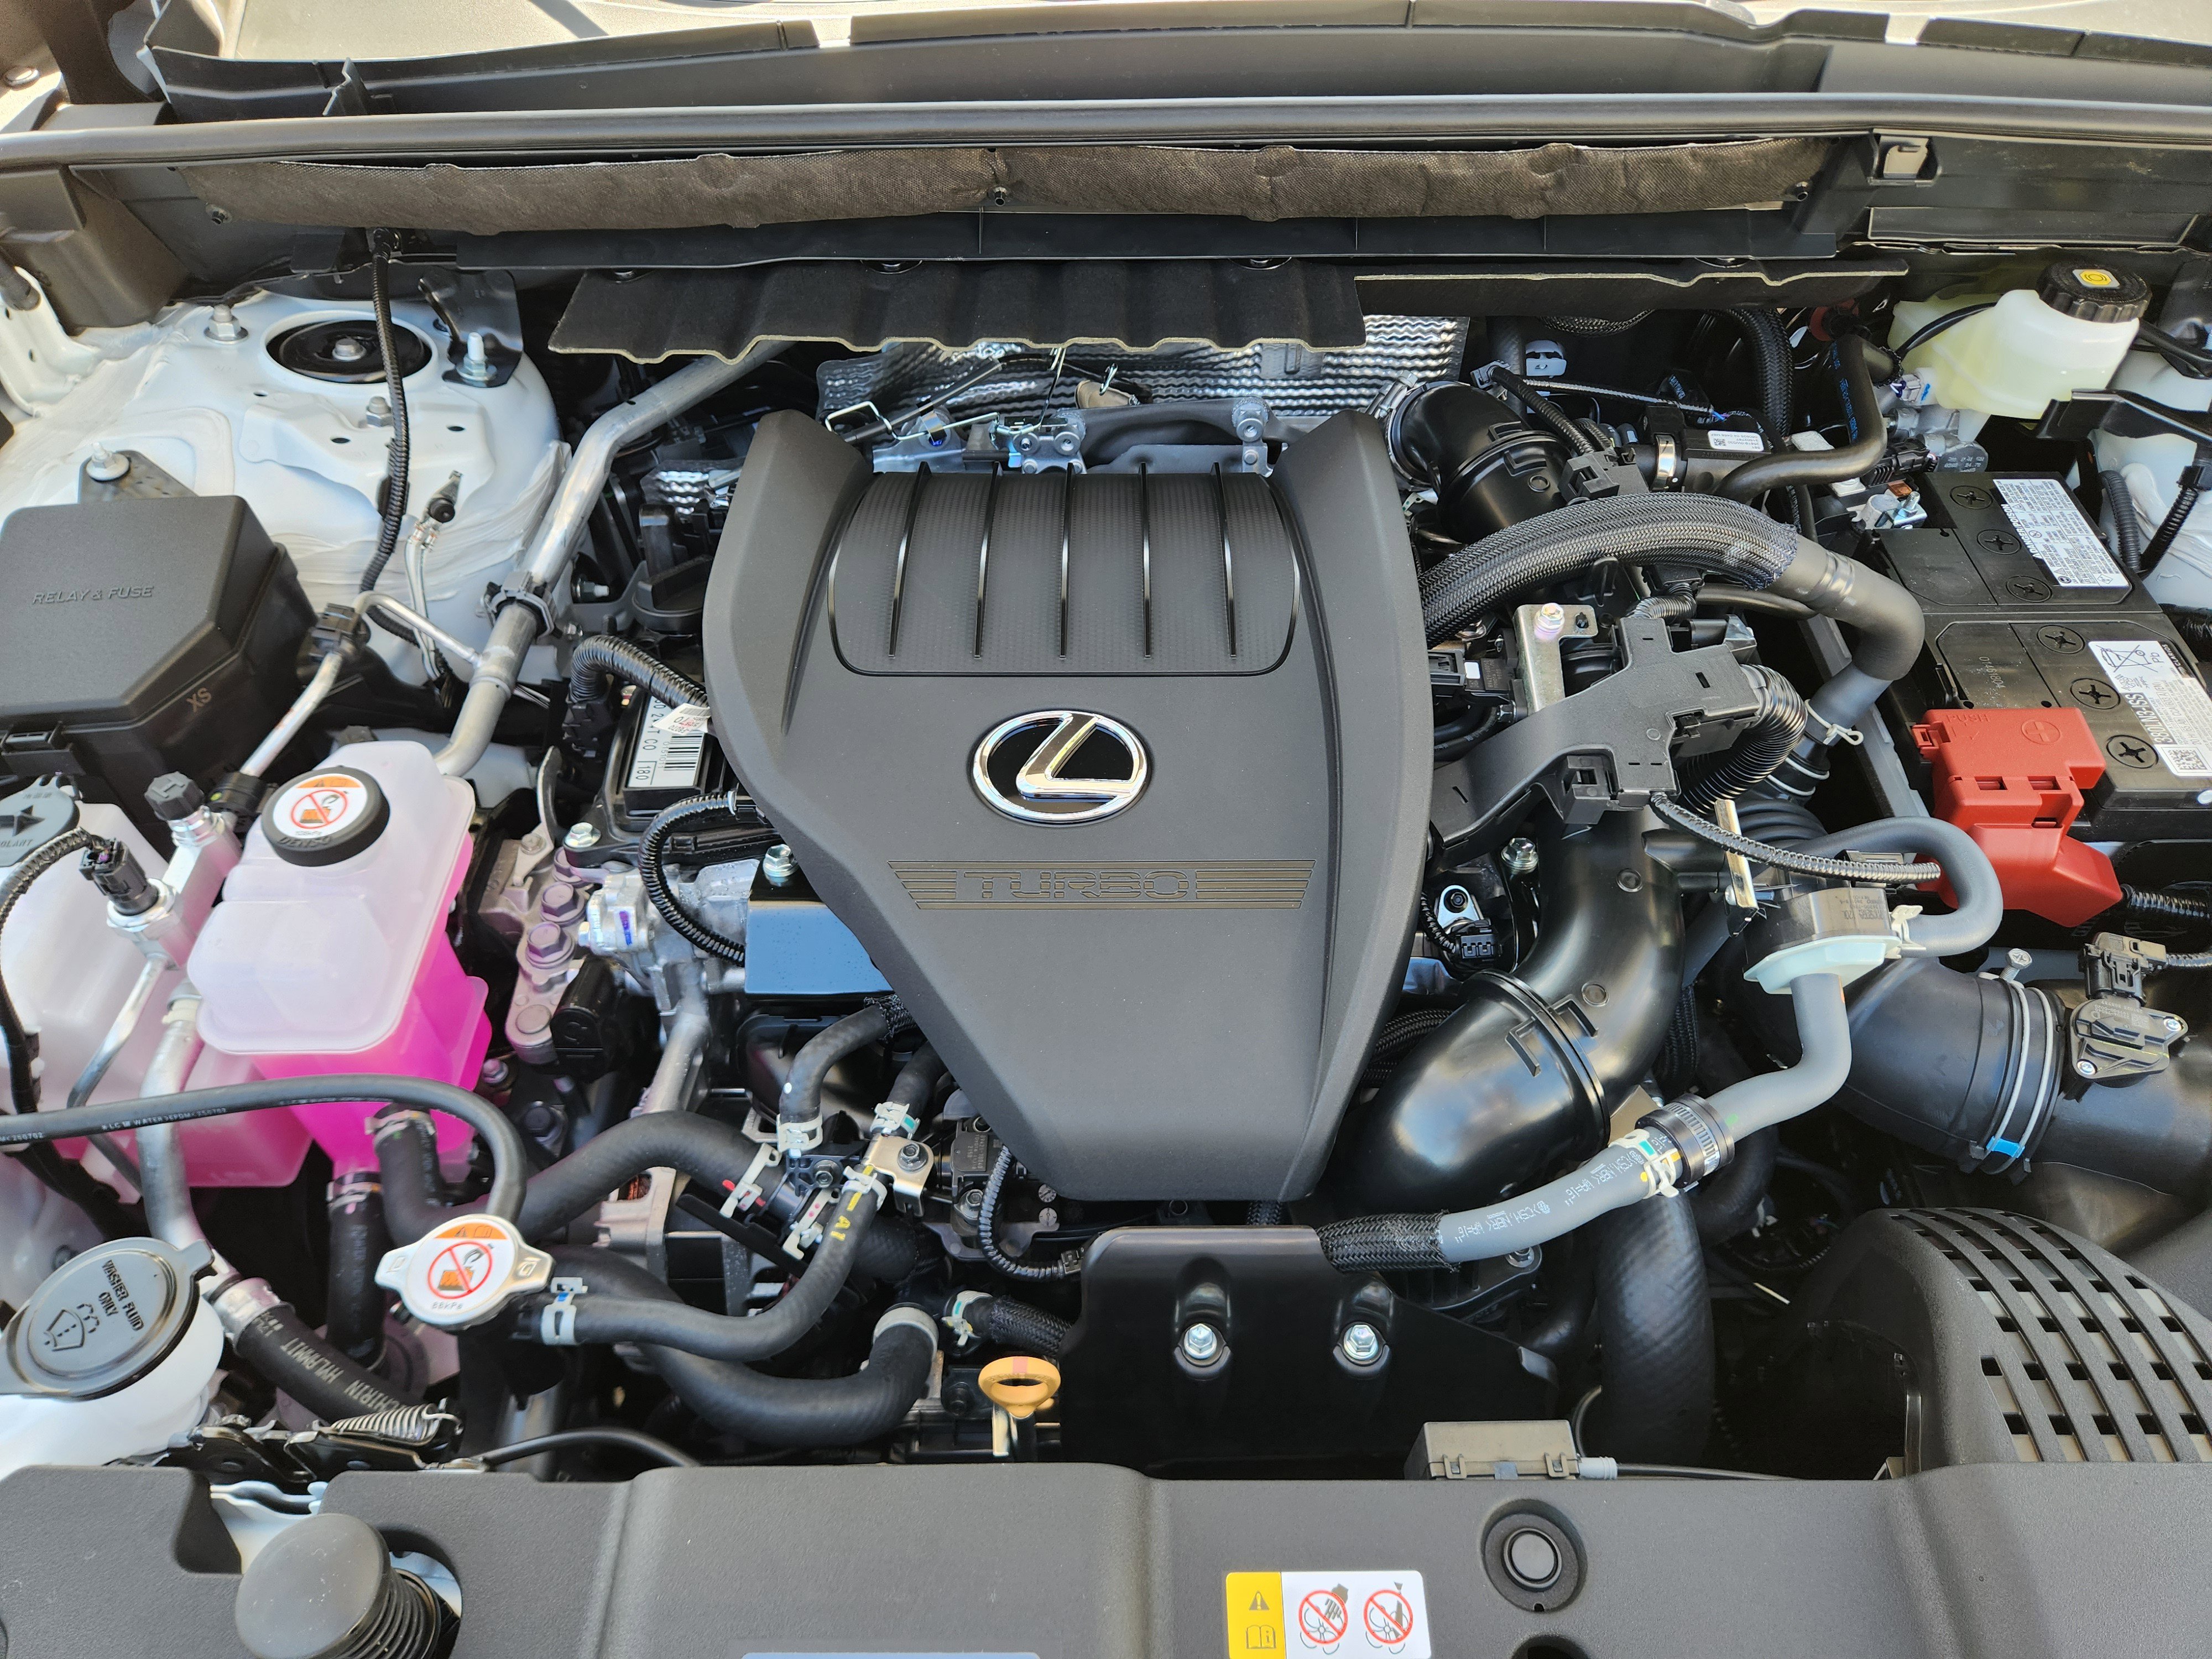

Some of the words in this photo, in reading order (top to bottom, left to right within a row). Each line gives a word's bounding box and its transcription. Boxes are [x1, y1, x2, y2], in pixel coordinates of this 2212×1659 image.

[2000, 503, 2039, 553] DANGER/POISON
[32, 589, 91, 604] RELAY
[91, 588, 103, 601] &
[108, 585, 155, 599] FUSE
[2150, 652, 2163, 664] Pb
[2161, 644, 2182, 666] CLARIOS
[186, 687, 212, 712] XS
[1946, 713, 1990, 723] PUSH
[2124, 693, 2175, 743] 380LN3-ISS
[635, 765, 650, 780] 180
[963, 870, 1190, 899] TURBO
[133, 1115, 163, 1126] WATER
[98, 1291, 119, 1317] ONLY
[101, 1259, 129, 1301] WASHER
[122, 1301, 145, 1332] FLUID
[342, 1379, 403, 1413] CHIRIN
